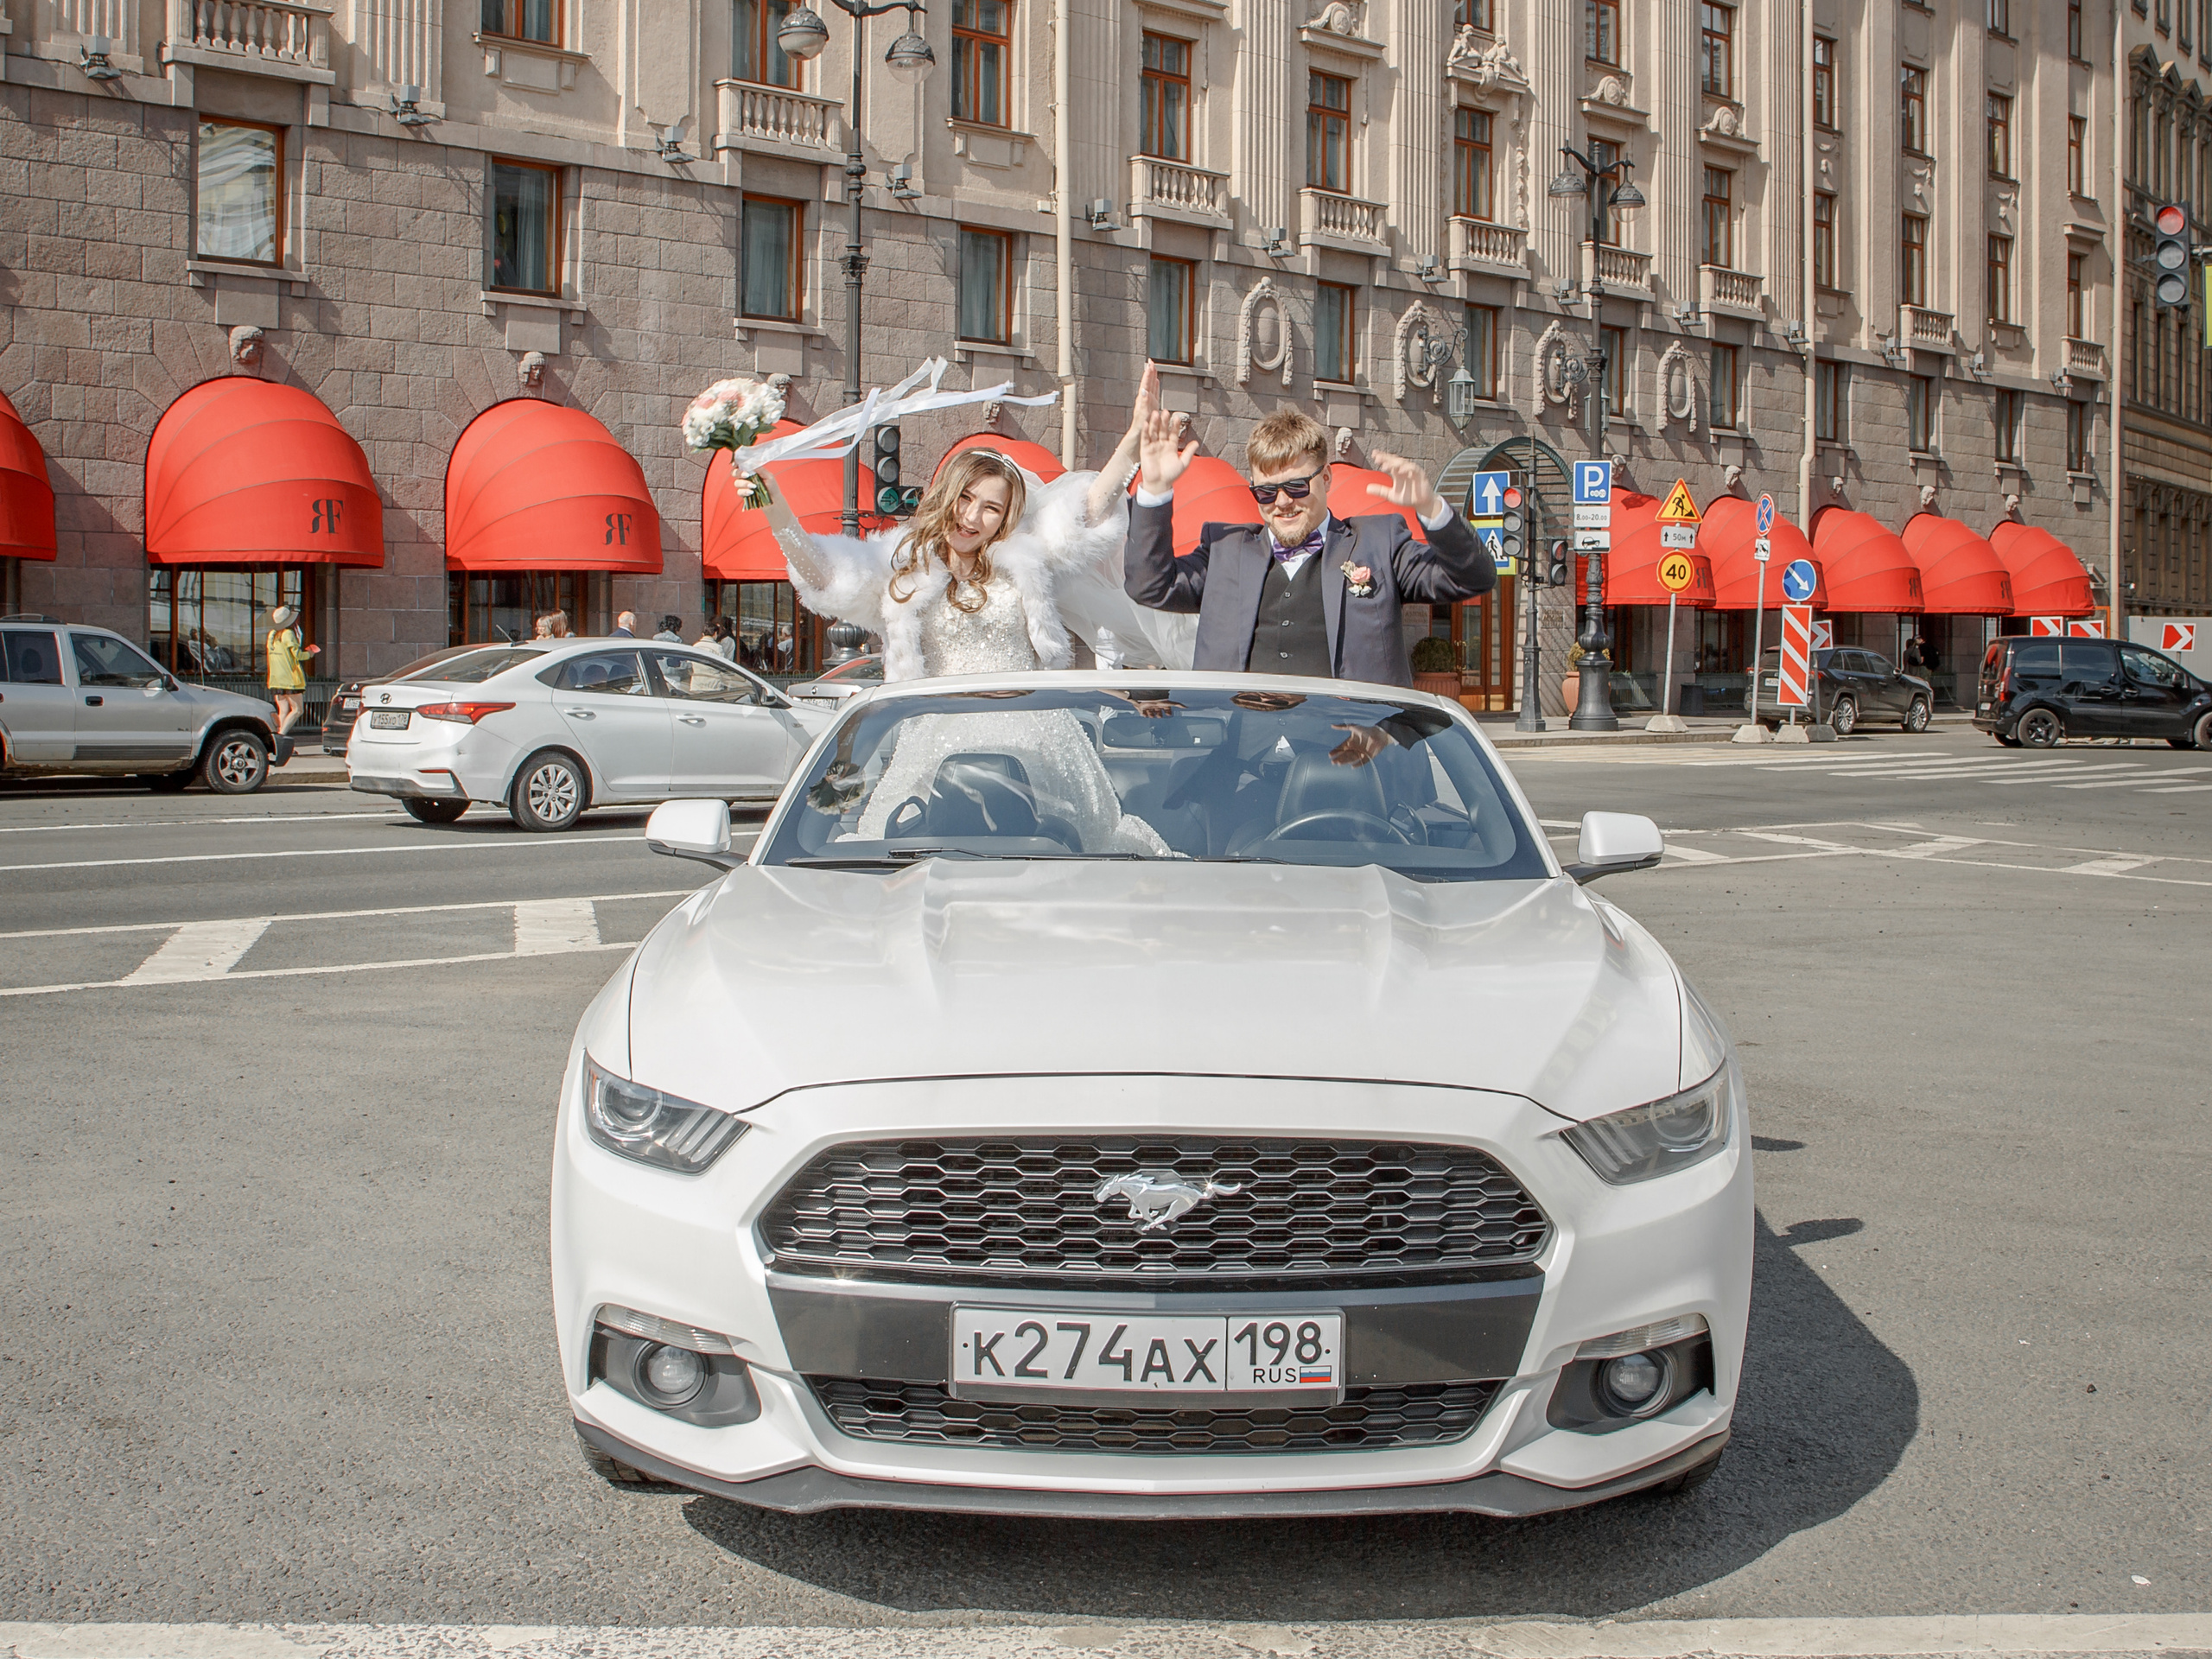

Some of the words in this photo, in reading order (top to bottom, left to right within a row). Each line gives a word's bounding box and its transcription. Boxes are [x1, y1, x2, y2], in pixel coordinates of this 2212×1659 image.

[1584, 466, 1604, 499] P
[1666, 563, 1687, 580] 40
[1233, 1320, 1323, 1366] 198
[1253, 1368, 1297, 1384] RUS
